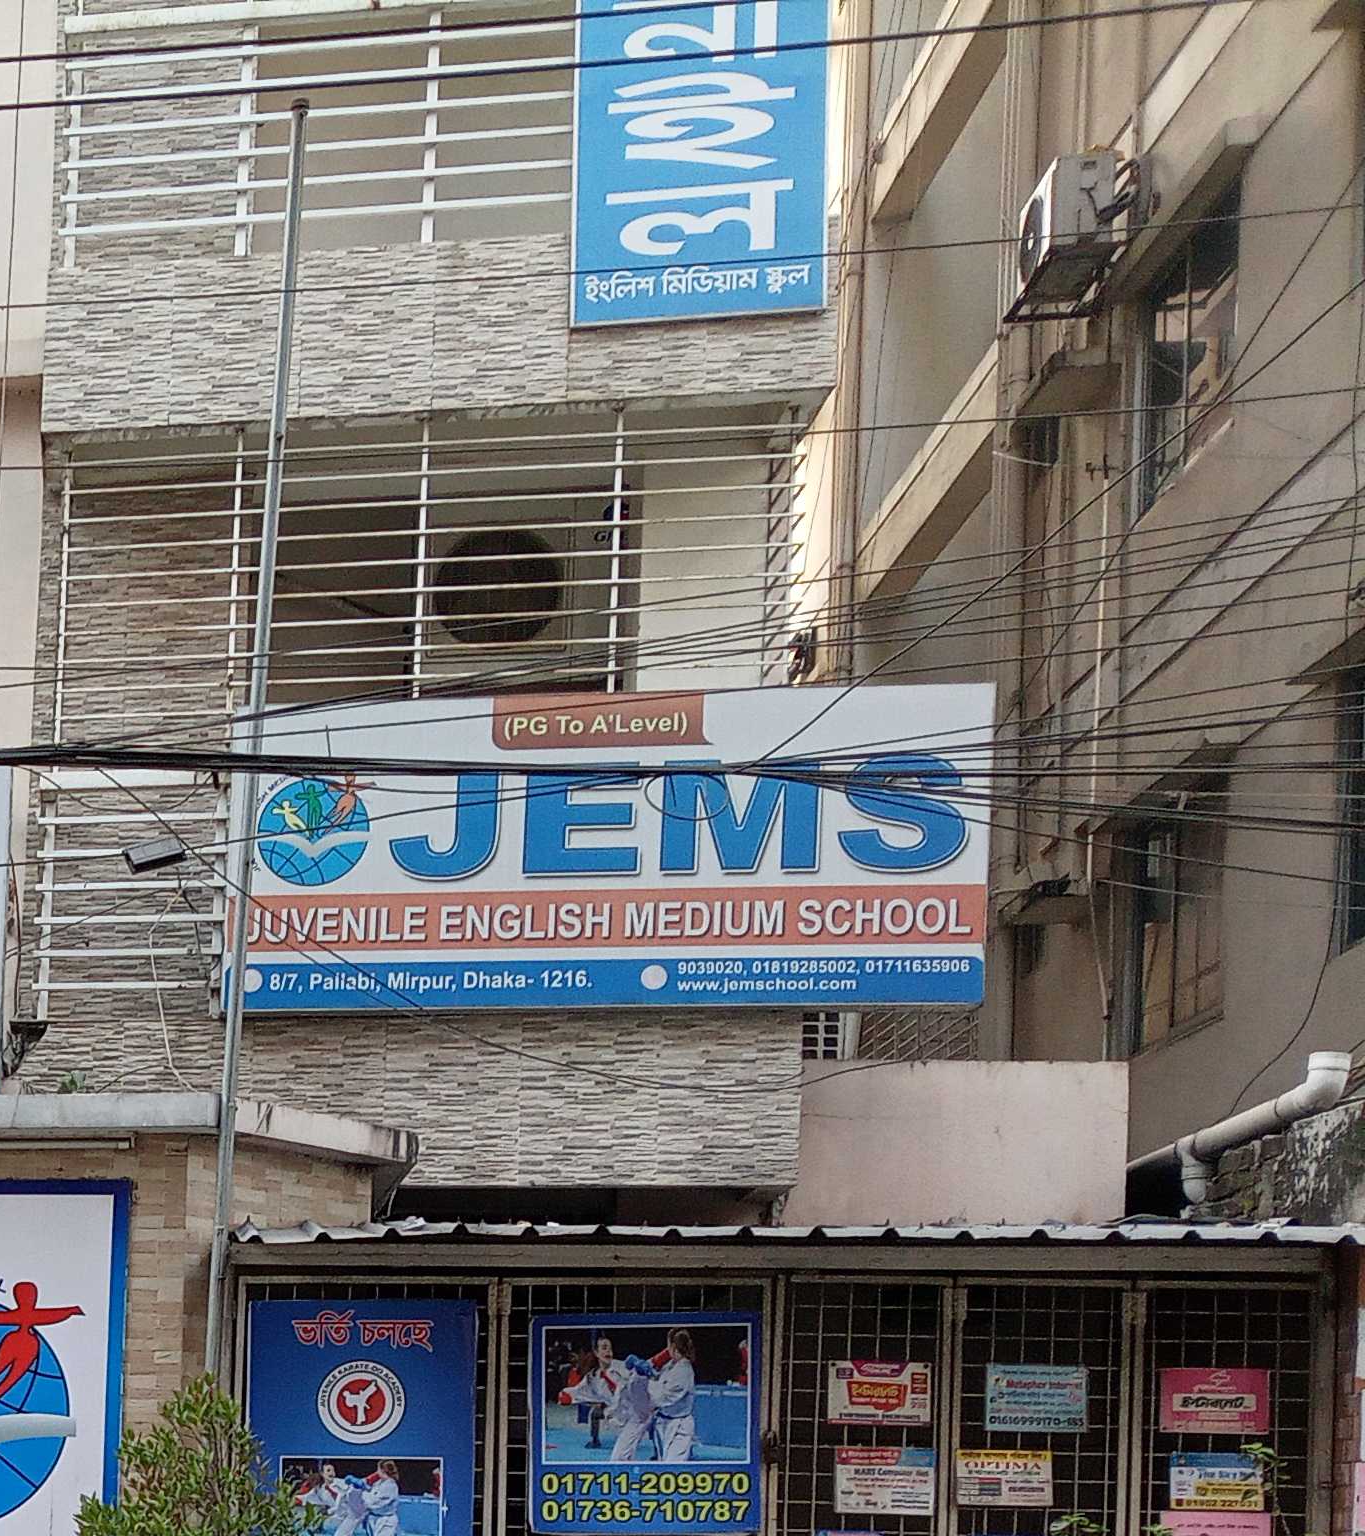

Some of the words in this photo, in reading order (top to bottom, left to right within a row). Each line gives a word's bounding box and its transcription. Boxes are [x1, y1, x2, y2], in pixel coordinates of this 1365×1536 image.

[584, 268, 656, 304] ইংলিশ
[661, 264, 758, 296] মিডিয়াম
[765, 261, 813, 295] স্কুল
[503, 715, 549, 742] (PG
[555, 716, 584, 735] To
[388, 753, 971, 880] JEMS
[247, 905, 428, 944] JUVENILE
[439, 902, 613, 942] ENGLISH
[624, 899, 785, 939] MEDIUM
[797, 898, 973, 937] SCHOOL
[677, 977, 857, 993] www.jemschool.com
[291, 1309, 356, 1349] ভর্তি
[355, 1319, 435, 1353] চলছে
[540, 1472, 751, 1497] 01711-209970
[540, 1499, 752, 1523] 01736-710787
